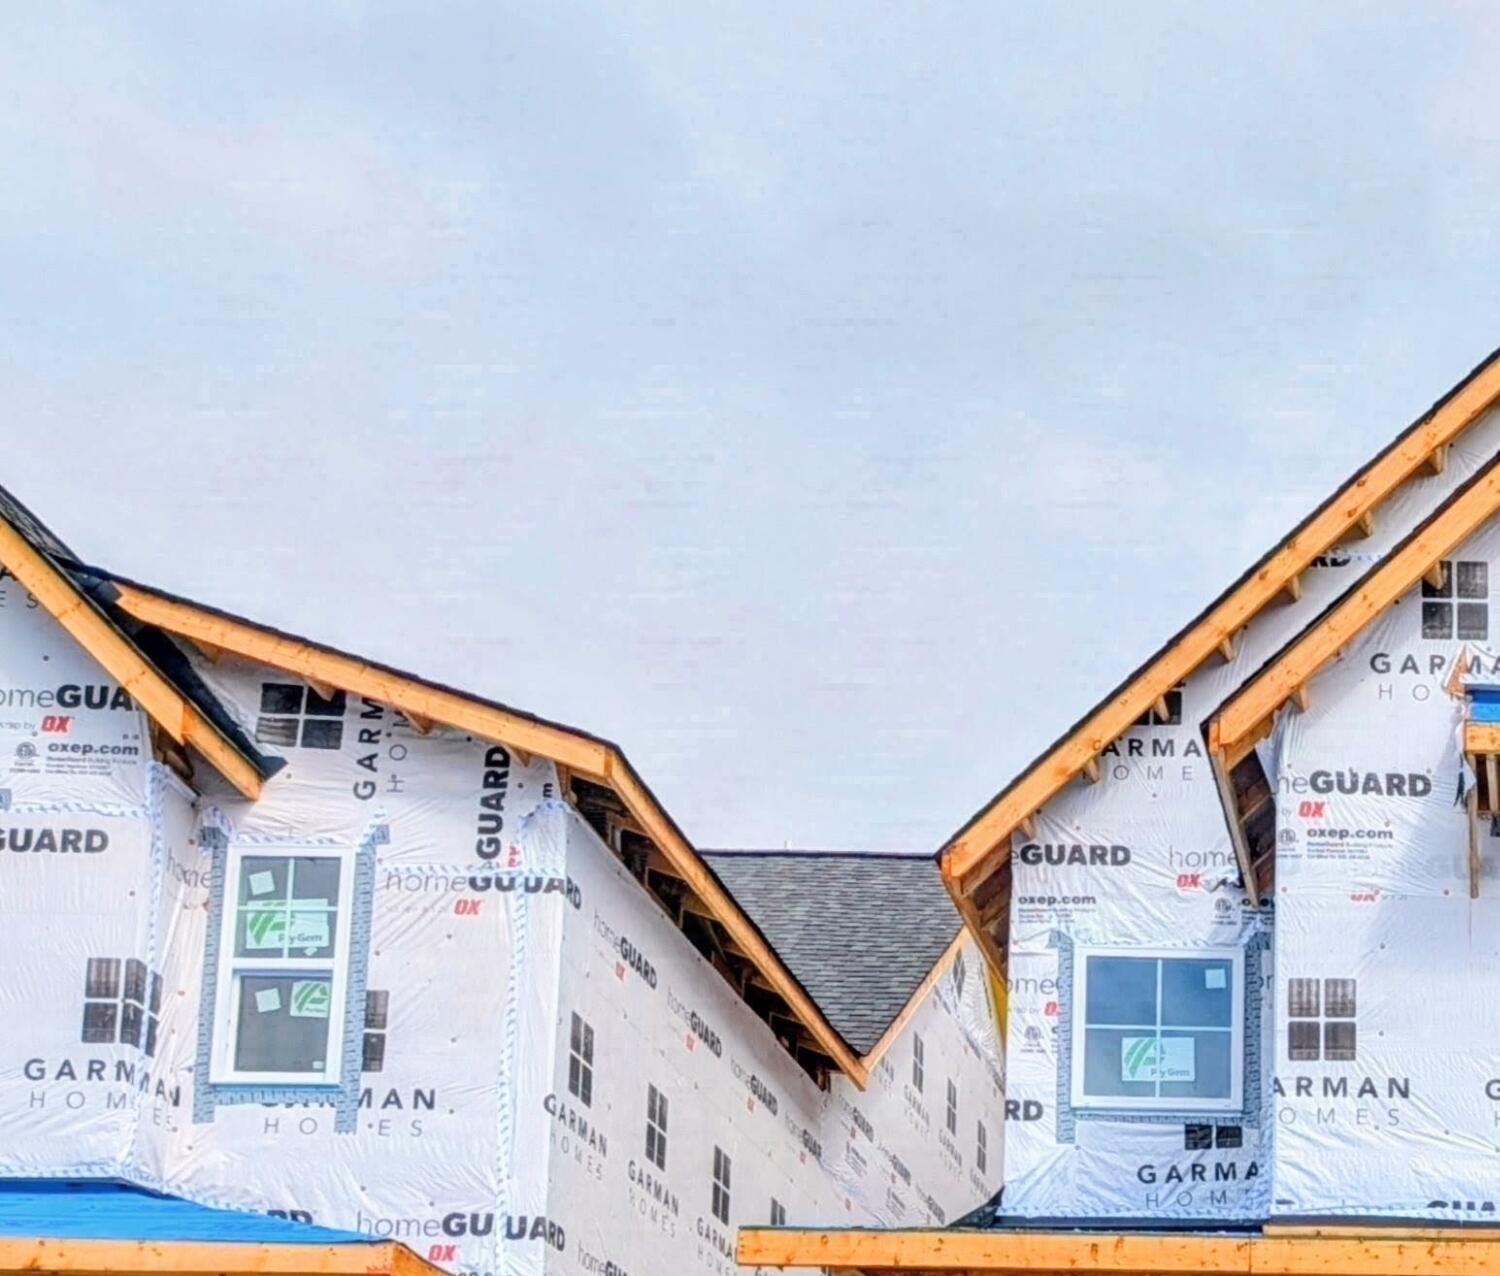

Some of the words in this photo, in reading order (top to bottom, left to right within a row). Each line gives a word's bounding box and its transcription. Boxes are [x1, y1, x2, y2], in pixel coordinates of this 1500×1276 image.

[41, 716, 71, 733] OX
[48, 743, 139, 756] oxep.com
[1299, 801, 1325, 818] OX
[0, 829, 109, 853] UARD
[1307, 827, 1394, 840] oxep.com
[454, 899, 482, 916] OX
[1018, 894, 1097, 907] oxep.com
[543, 1093, 608, 1158] GARMAN
[1278, 1107, 1401, 1127] OMES
[264, 1117, 423, 1136] HOES
[1137, 1162, 1259, 1185] GARMA
[628, 1160, 679, 1218] GARMAN
[428, 1244, 457, 1262] OX
